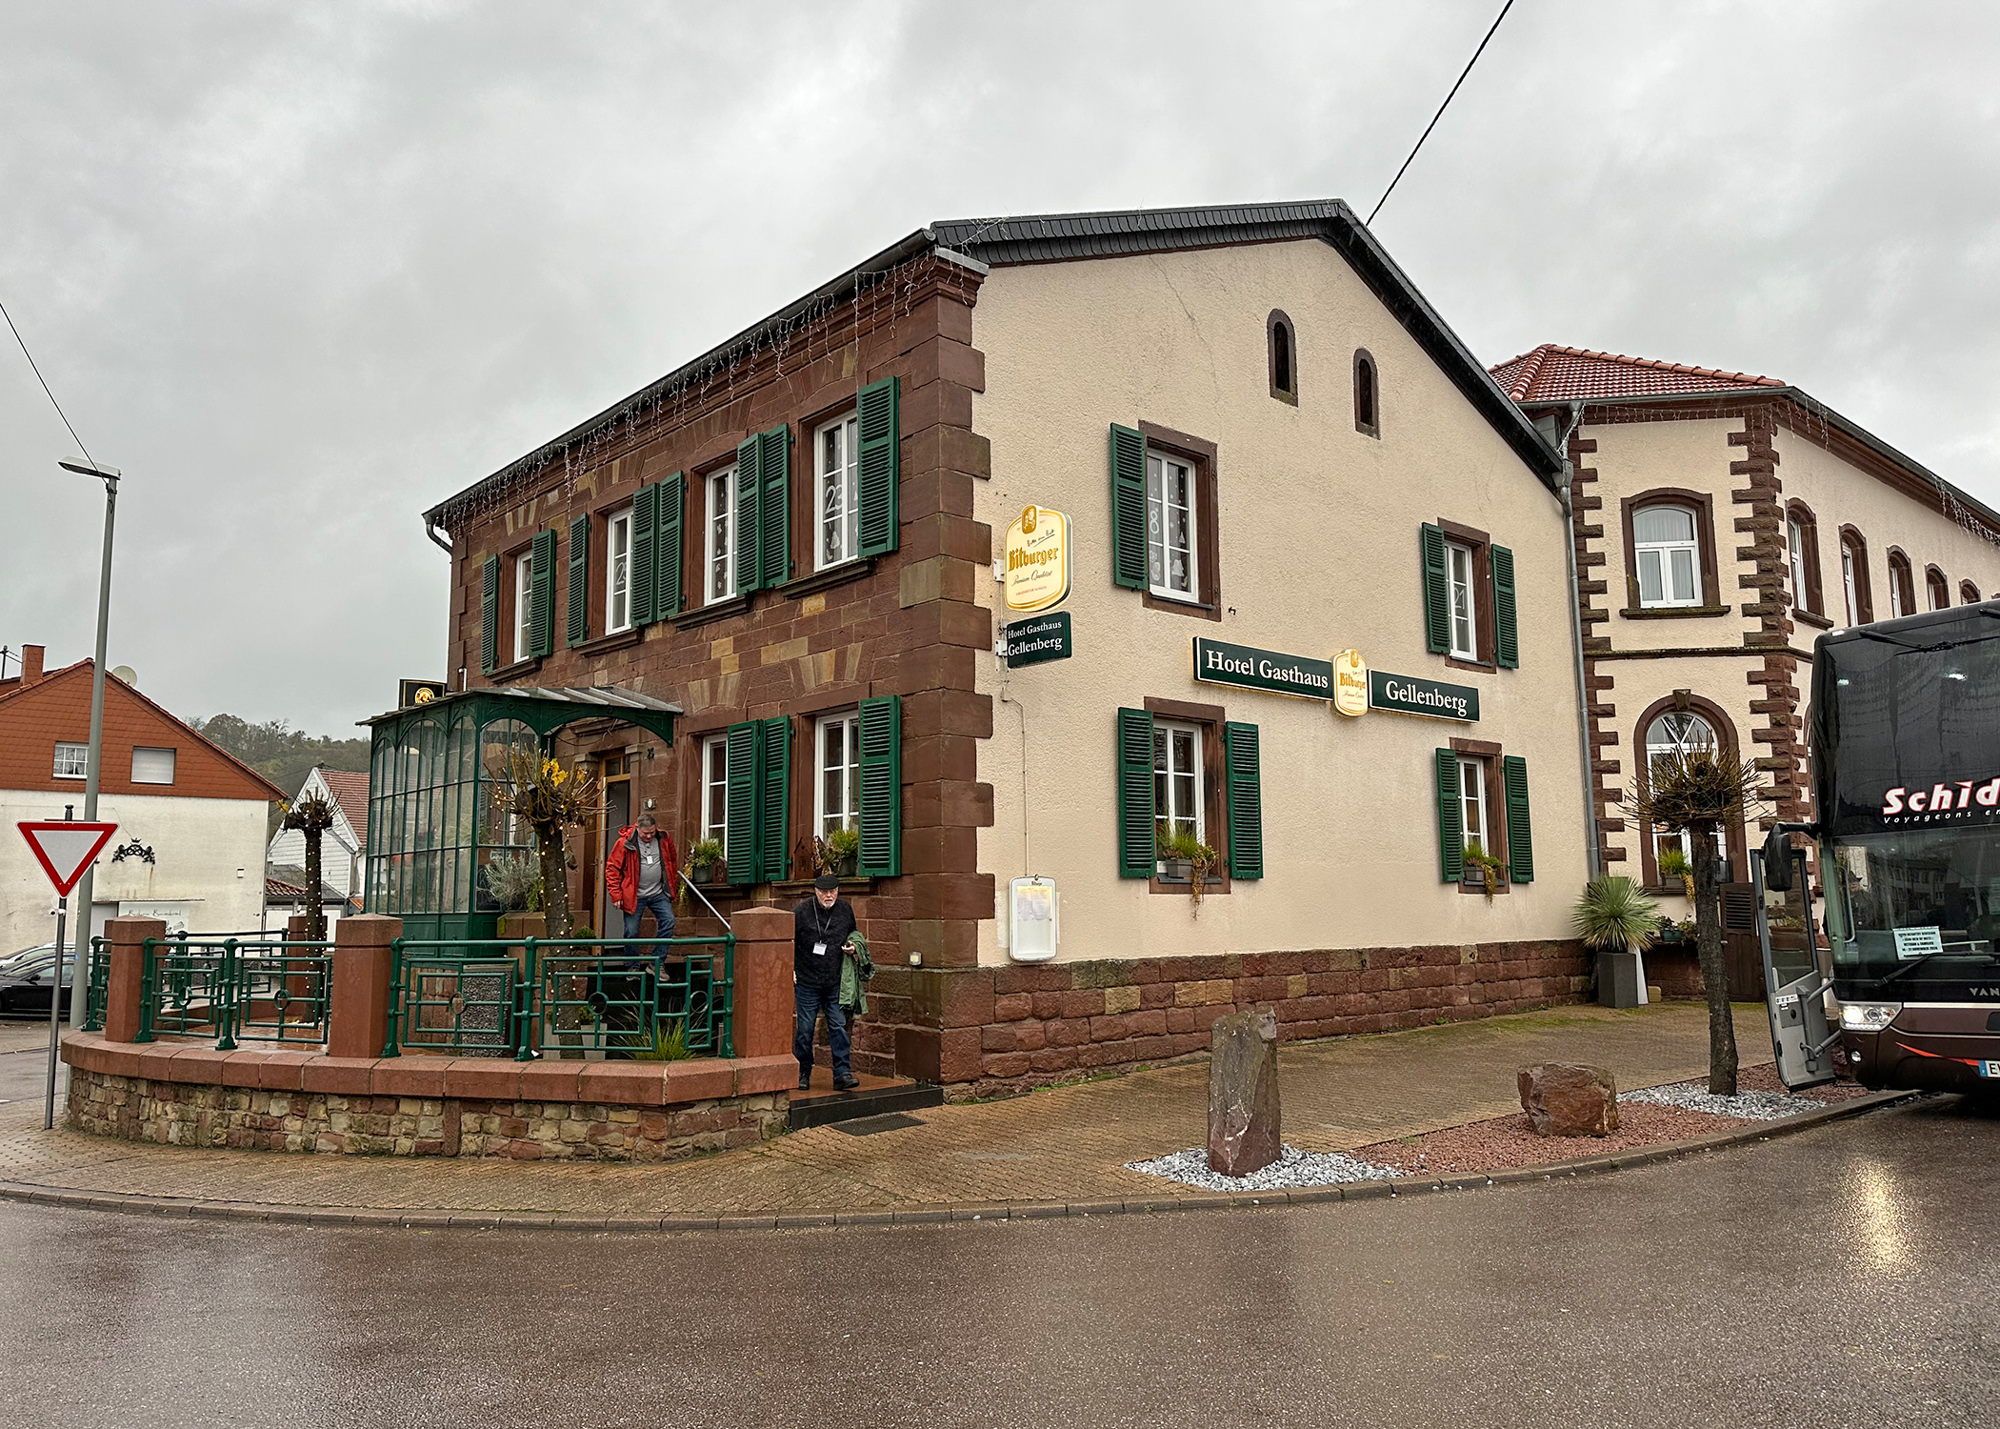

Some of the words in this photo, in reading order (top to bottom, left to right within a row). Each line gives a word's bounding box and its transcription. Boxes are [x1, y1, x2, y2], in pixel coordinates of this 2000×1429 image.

[1008, 547, 1059, 572] Bitburger
[1007, 627, 1026, 640] Hotel
[1026, 619, 1063, 634] Gasthaus
[1007, 637, 1063, 657] Gellenberg
[1206, 649, 1255, 676] Hotel
[1259, 659, 1329, 689] Gasthaus
[1385, 680, 1467, 717] Gellenberg
[1882, 777, 2000, 815] Schid
[1883, 810, 1972, 824] Voyageons
[1969, 987, 2000, 997] VAN
